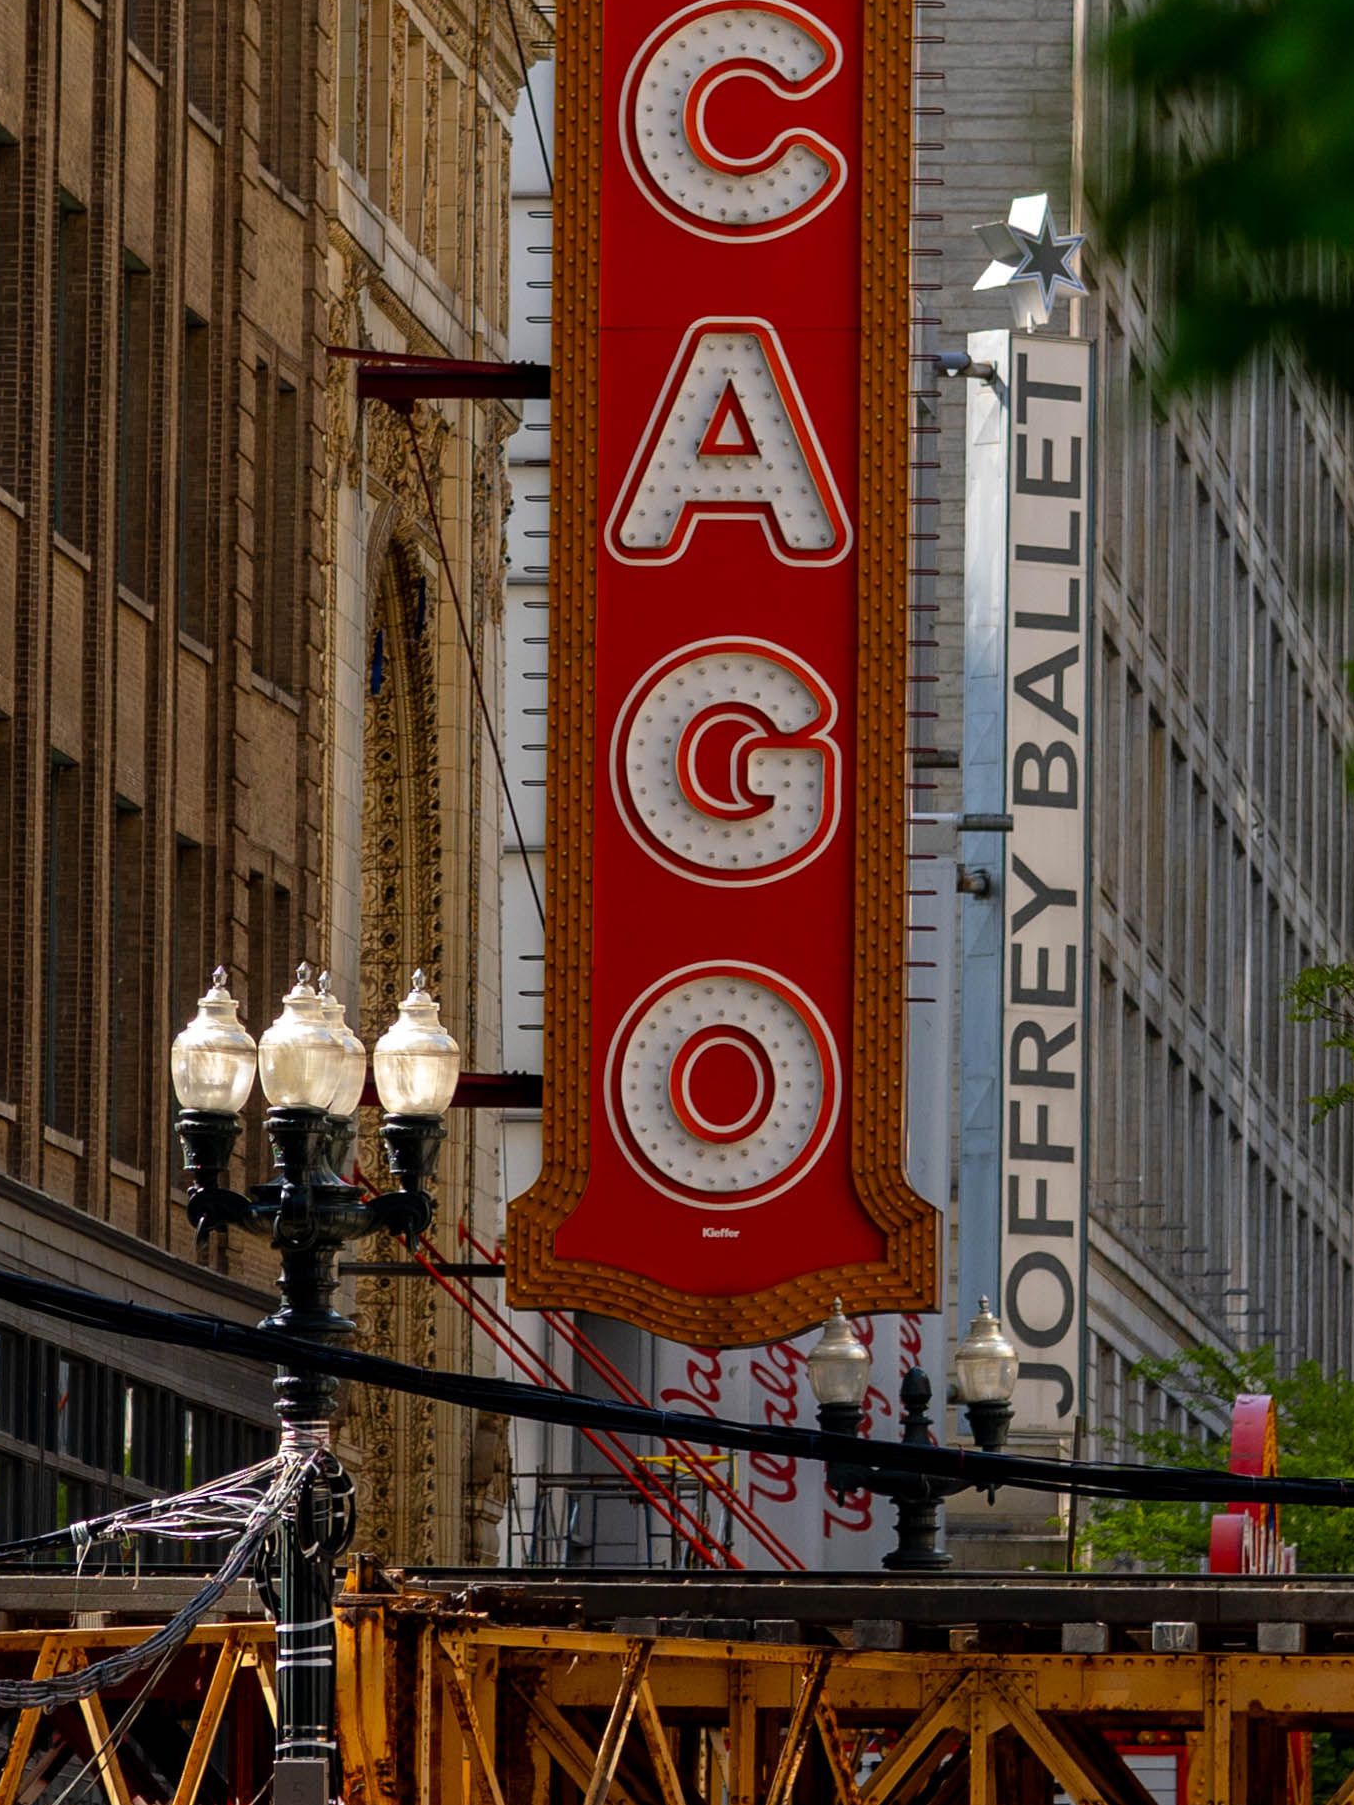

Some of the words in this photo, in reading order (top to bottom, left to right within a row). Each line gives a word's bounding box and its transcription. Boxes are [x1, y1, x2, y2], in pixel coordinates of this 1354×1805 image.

[1013, 352, 1083, 810] BALLET
[702, 1227, 741, 1238] Kieffer
[1005, 856, 1079, 1418] JOFFREY
